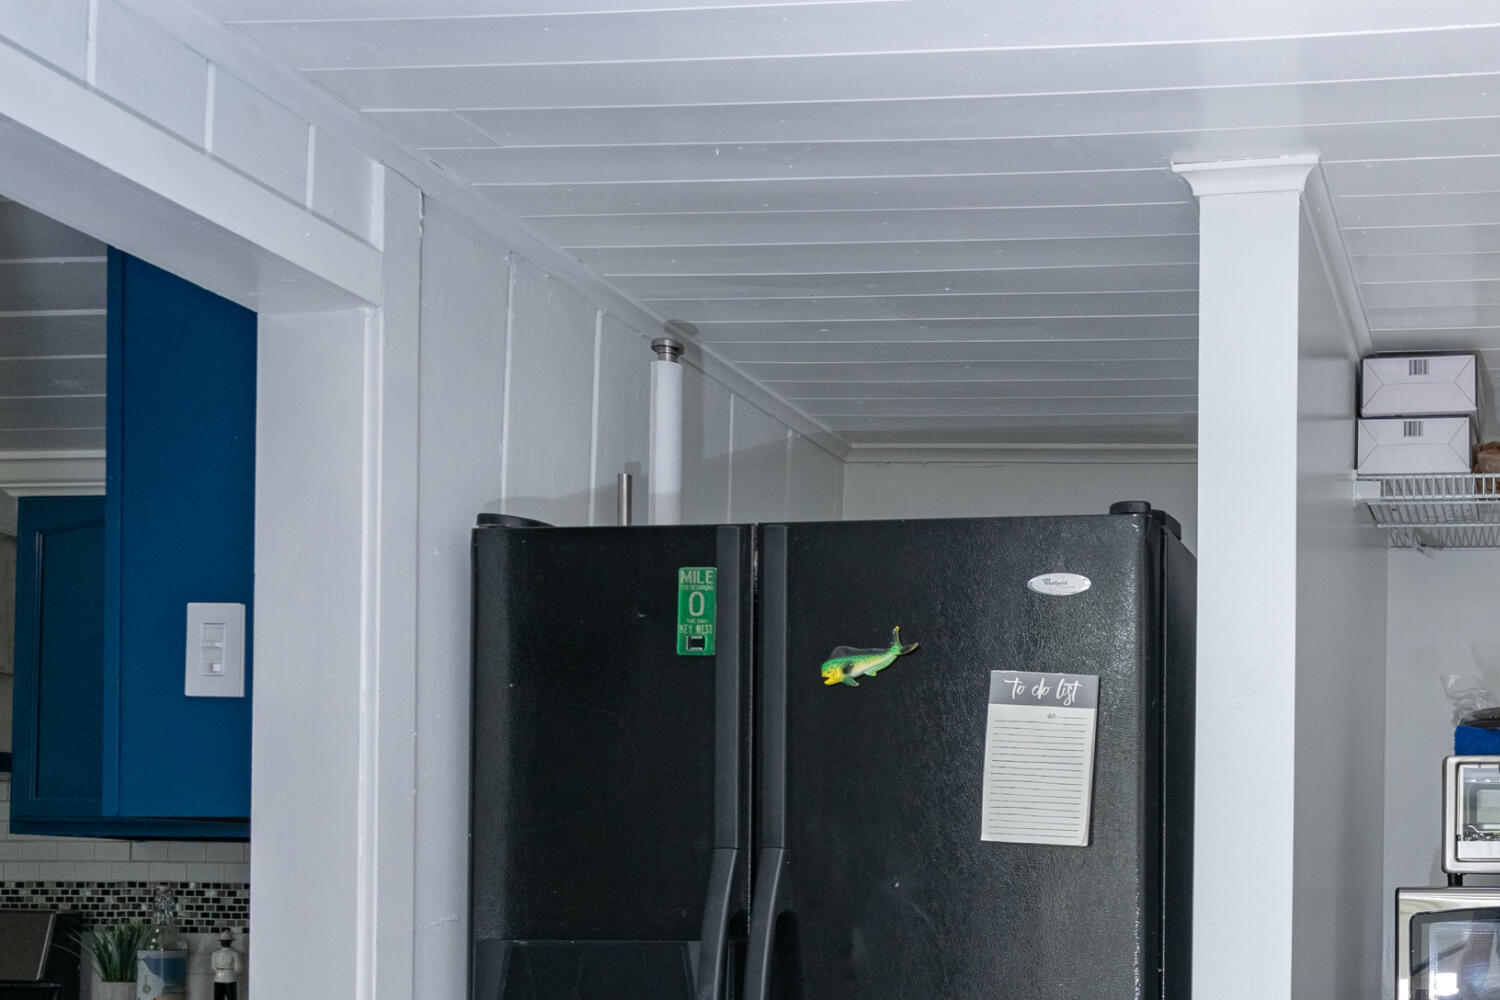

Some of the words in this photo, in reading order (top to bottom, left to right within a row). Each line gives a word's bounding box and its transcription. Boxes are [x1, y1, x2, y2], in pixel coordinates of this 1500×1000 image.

[680, 570, 714, 584] MILE
[689, 591, 704, 617] 0
[680, 624, 693, 634] KEY
[695, 625, 713, 635] WEST
[1031, 677, 1052, 700] do
[1056, 678, 1083, 706] list
